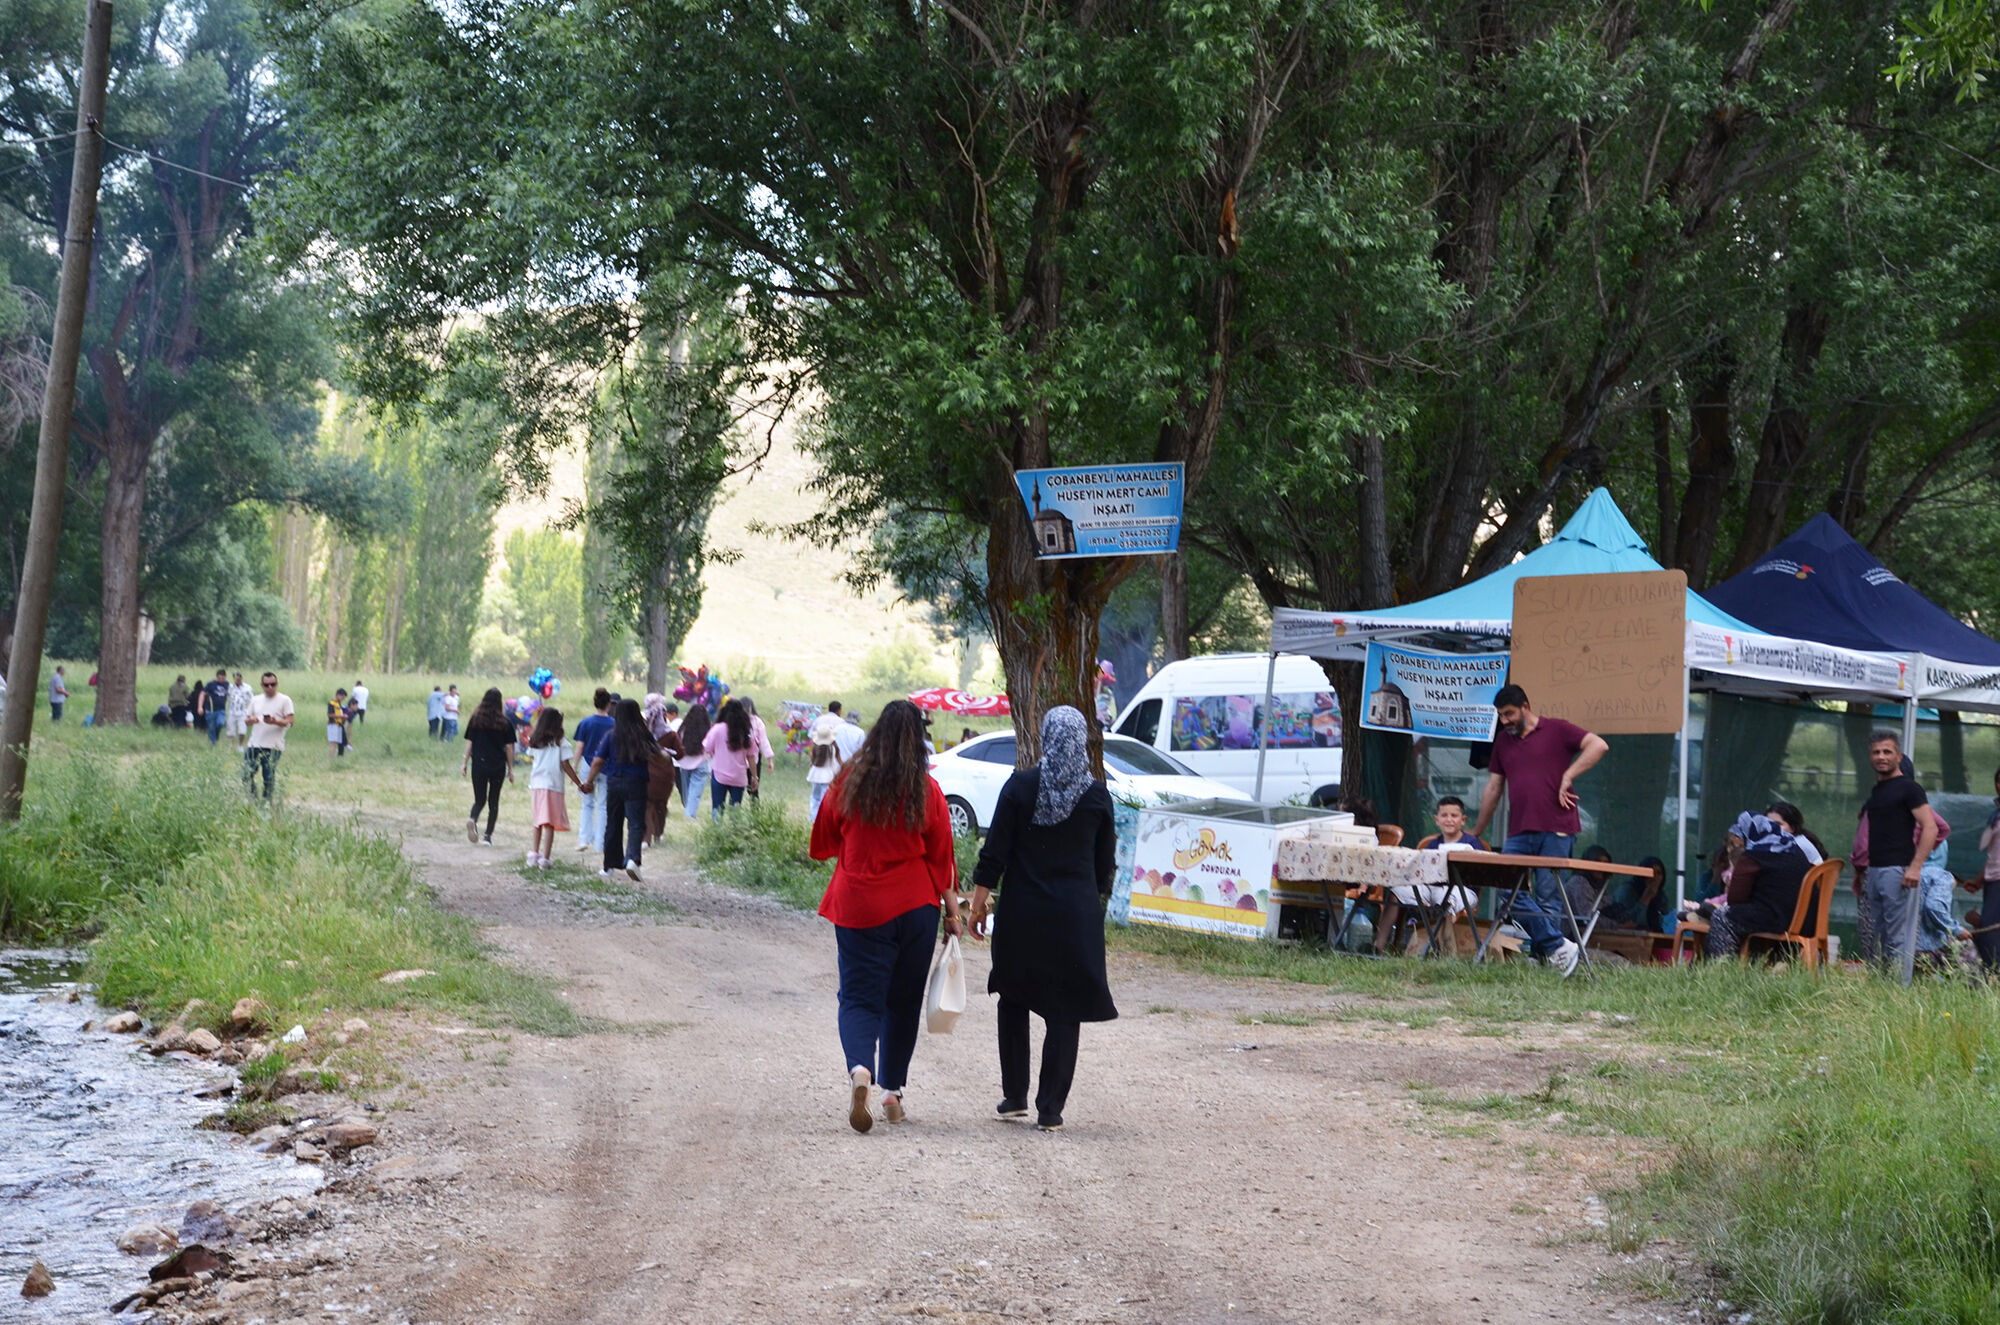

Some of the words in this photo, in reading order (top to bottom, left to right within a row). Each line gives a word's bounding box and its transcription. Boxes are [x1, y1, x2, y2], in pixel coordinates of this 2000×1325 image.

[1046, 470, 1114, 487] ÇOBANBEYLİ
[1116, 467, 1178, 483] MAHALLESİ
[1057, 488, 1104, 501] HÜSEYİN
[1106, 487, 1135, 499] MERT
[1093, 503, 1135, 517] İNŞAATI
[1389, 652, 1441, 670] ÇOBANBEYLİ
[1444, 658, 1505, 671] MAHALLESİ
[1397, 669, 1433, 685] HÜSEYİN
[1435, 675, 1463, 686] MERT
[1424, 688, 1464, 702] İNŞAATI
[1200, 863, 1241, 877] DONDURMA
